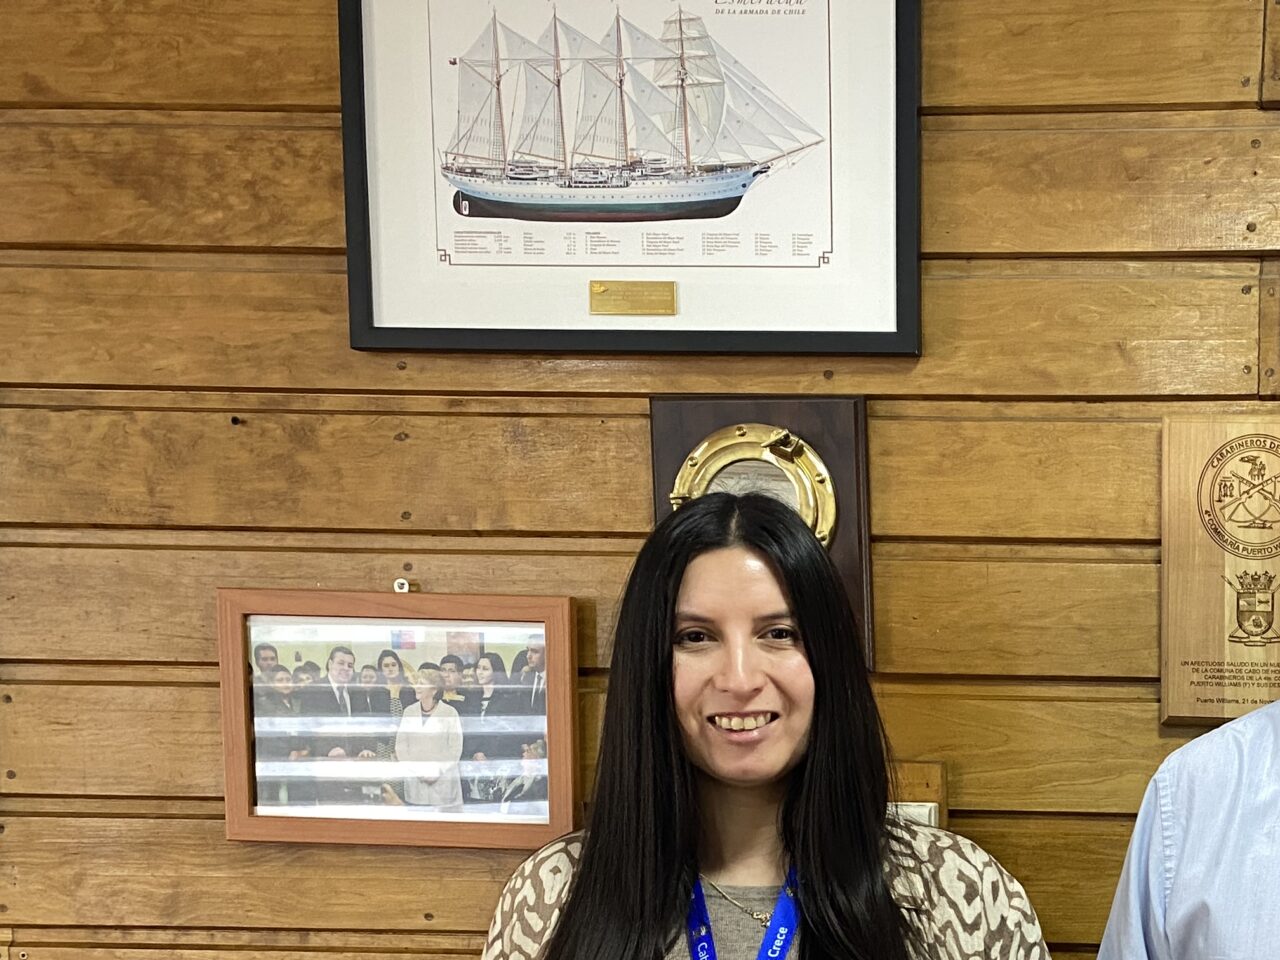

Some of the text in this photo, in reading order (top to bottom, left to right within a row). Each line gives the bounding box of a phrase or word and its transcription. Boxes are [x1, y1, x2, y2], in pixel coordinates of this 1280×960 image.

[1211, 438, 1267, 469] CARABINEROS
[1241, 546, 1273, 556] PUERTO
[768, 926, 788, 957] Crece
